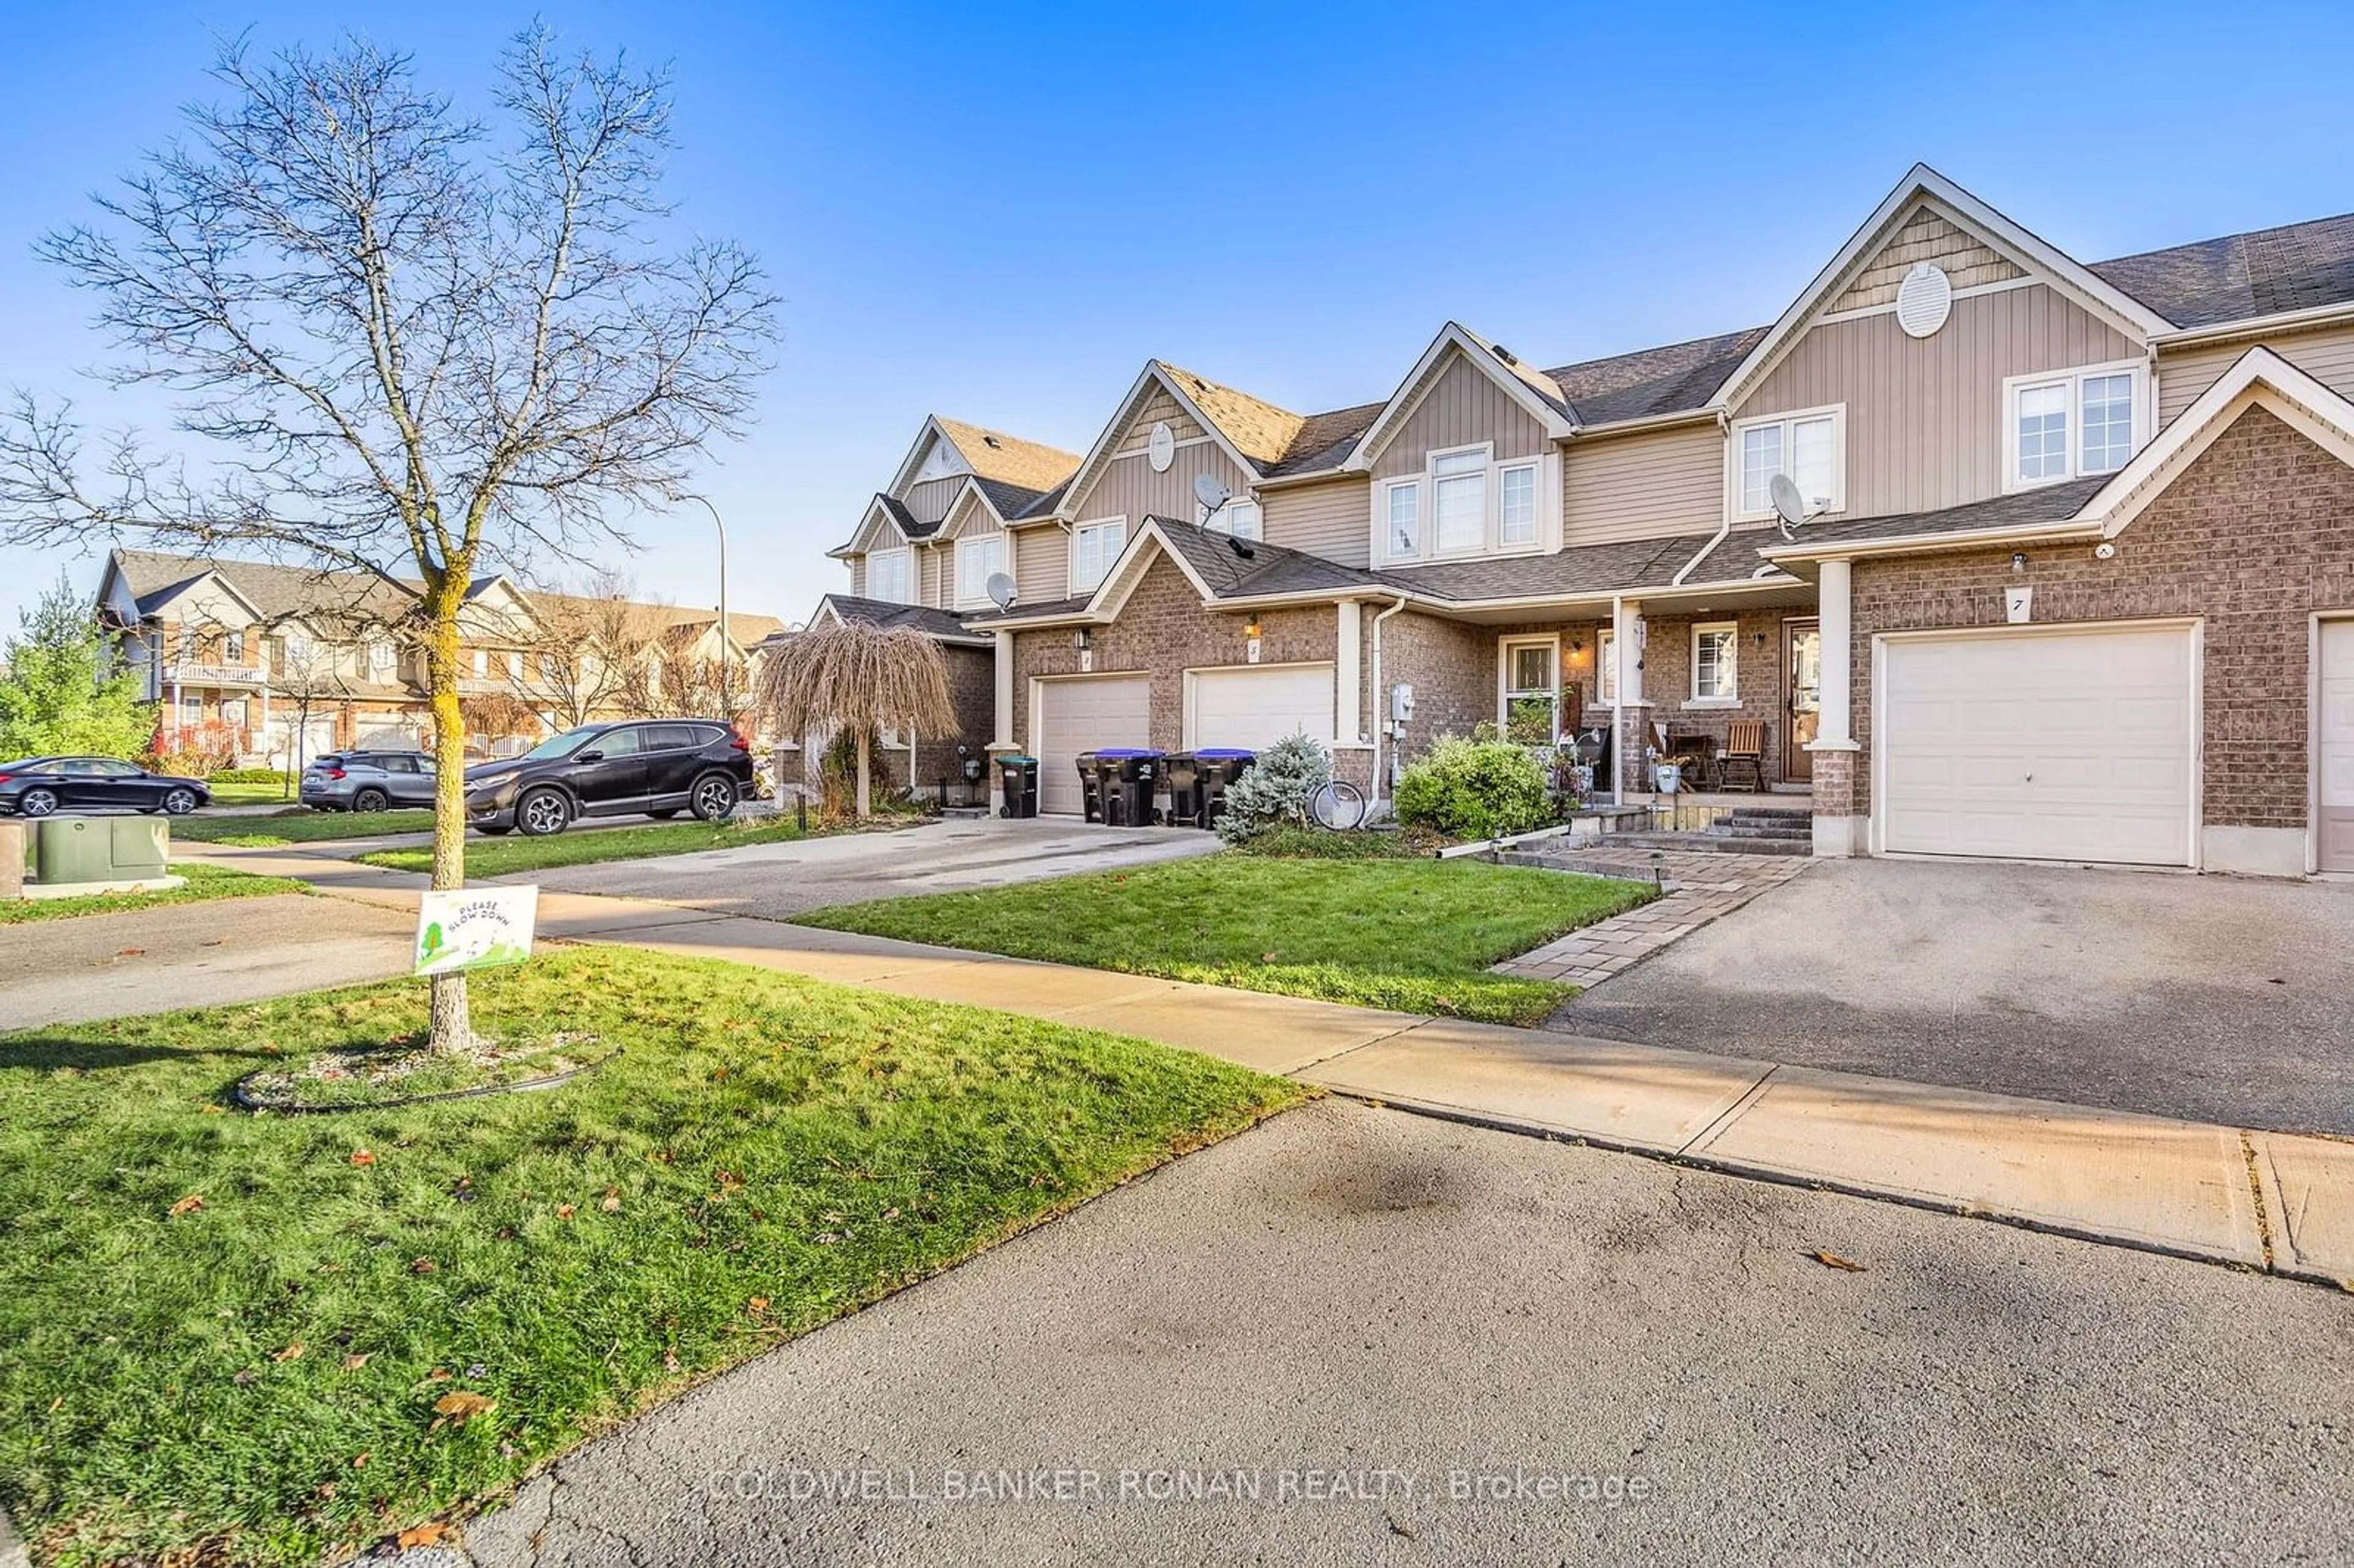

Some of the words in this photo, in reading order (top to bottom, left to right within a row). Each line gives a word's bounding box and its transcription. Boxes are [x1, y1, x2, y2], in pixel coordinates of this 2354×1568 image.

[2013, 600, 2024, 611] 7
[459, 900, 498, 915] PLEASE
[448, 911, 478, 932] SLOW
[481, 910, 511, 926] DOWN
